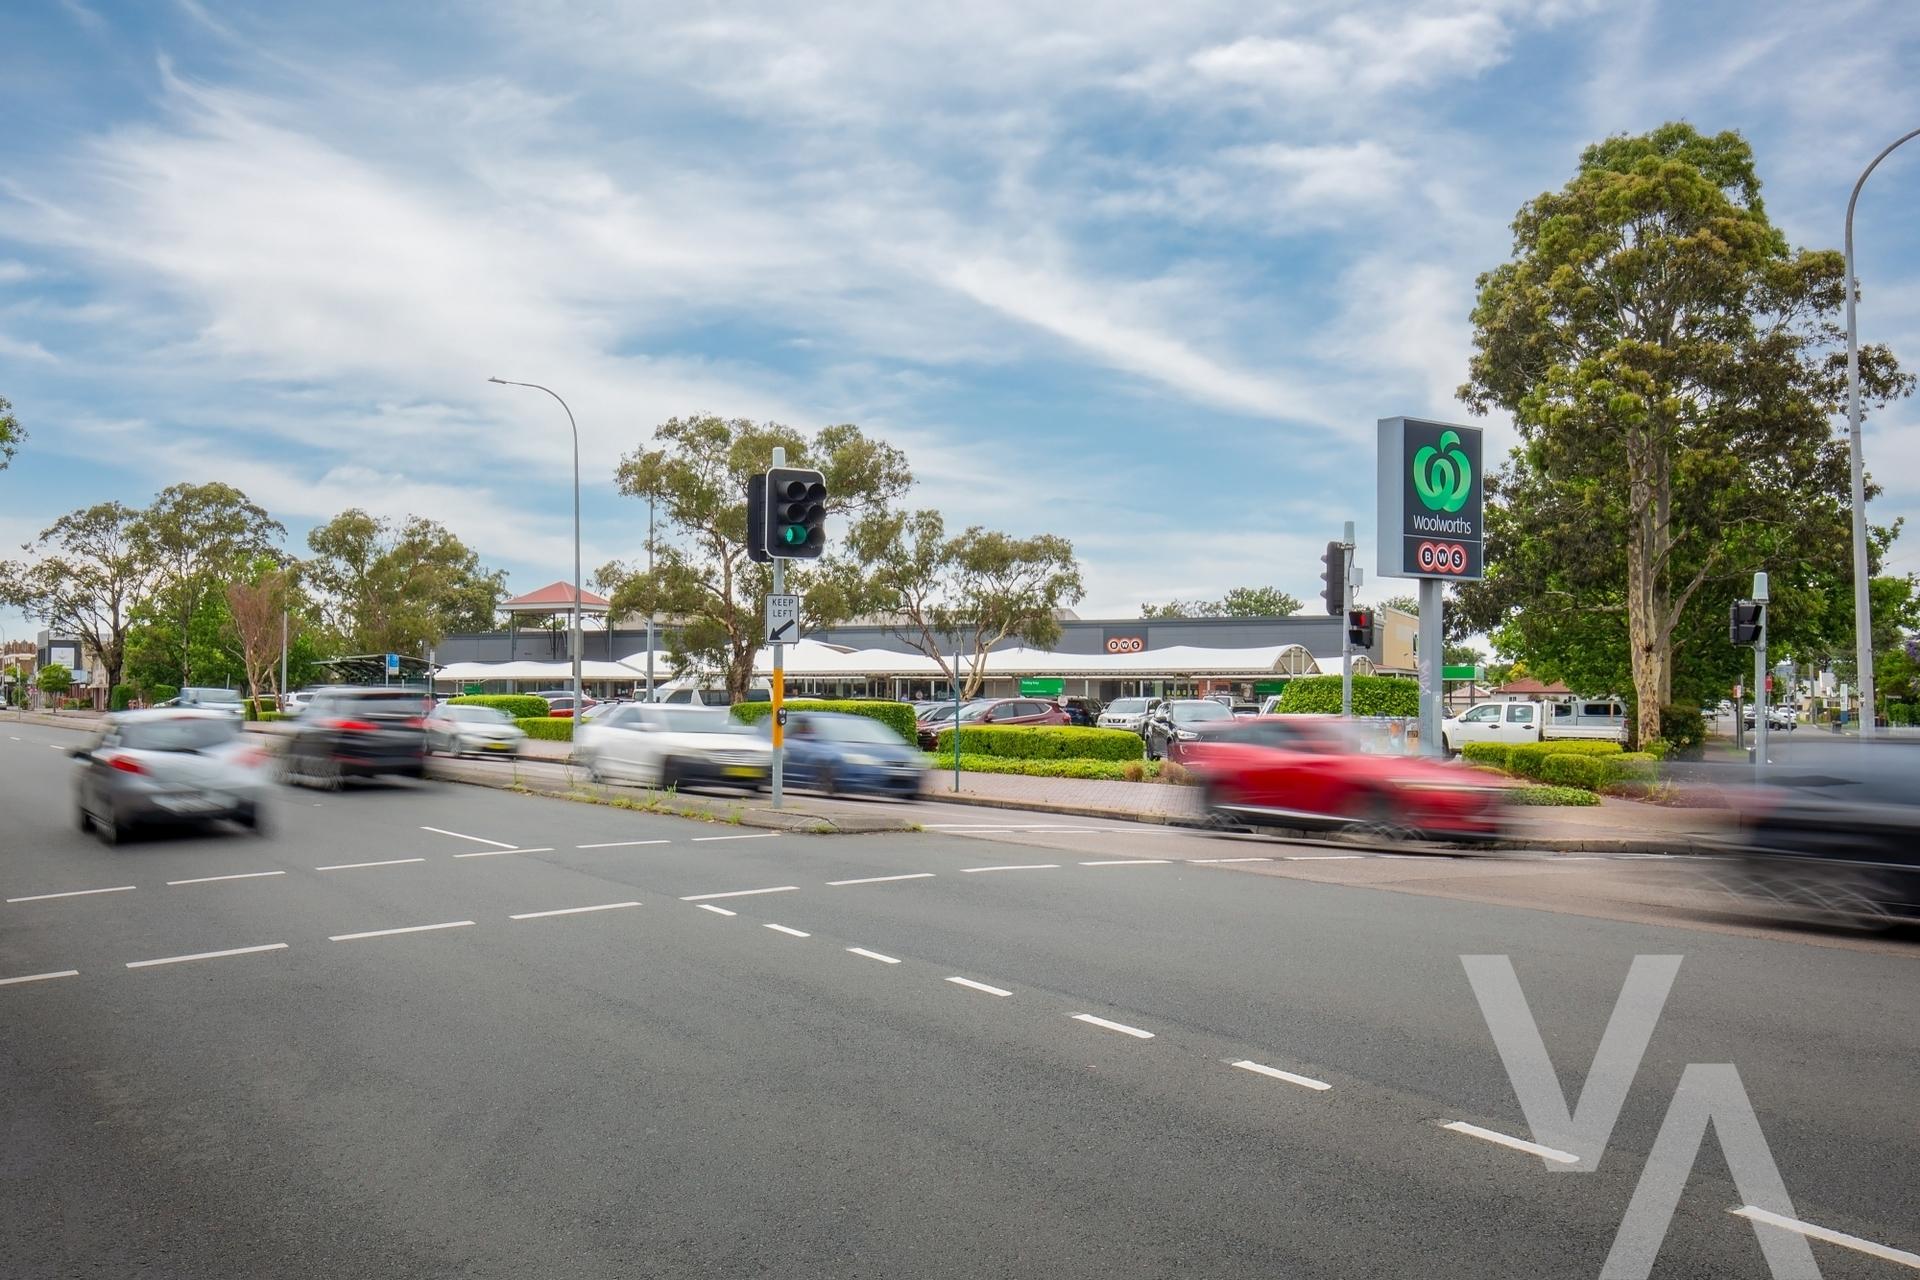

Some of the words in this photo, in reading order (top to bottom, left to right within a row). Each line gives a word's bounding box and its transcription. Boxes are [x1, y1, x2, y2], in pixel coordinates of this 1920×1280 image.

[1413, 514, 1472, 535] Woolworths
[772, 598, 794, 607] KEEP
[772, 609, 793, 618] LEFT
